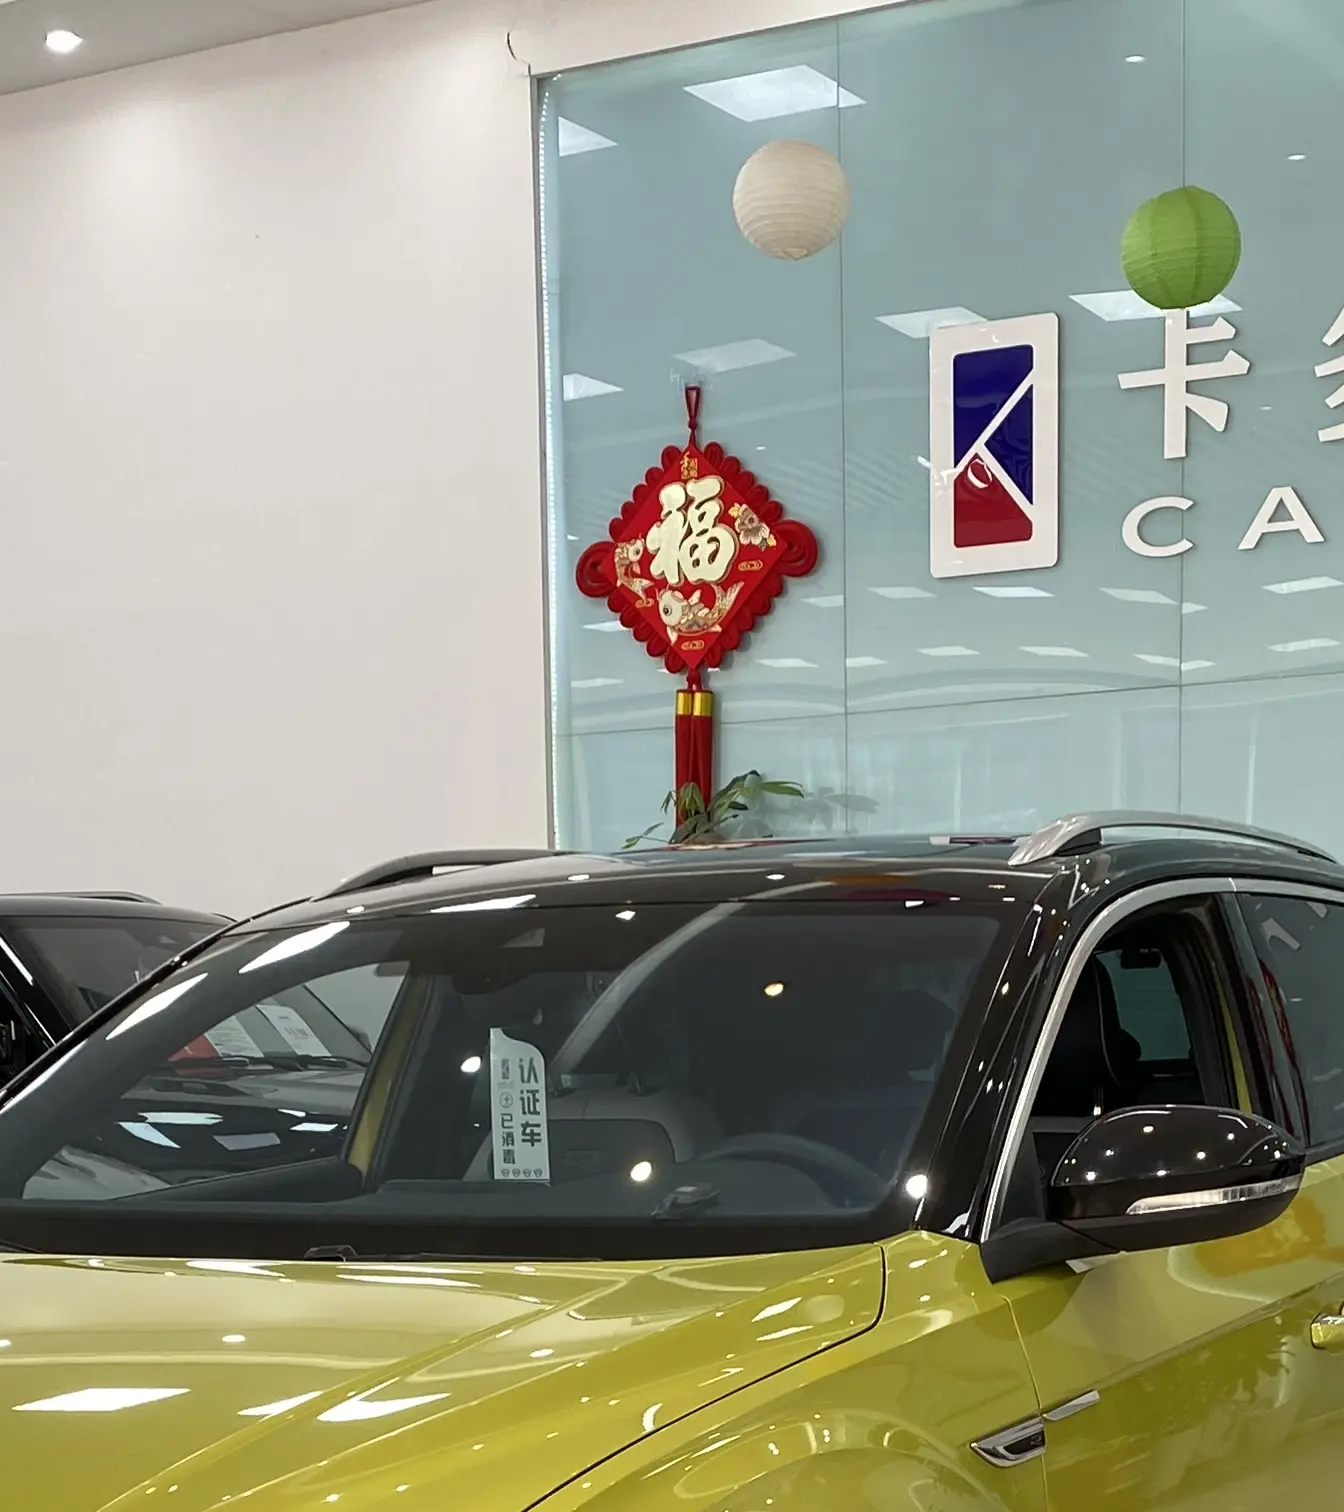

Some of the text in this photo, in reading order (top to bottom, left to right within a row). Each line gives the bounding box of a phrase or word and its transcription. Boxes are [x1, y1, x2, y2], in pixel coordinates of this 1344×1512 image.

[646, 475, 739, 586] 福
[518, 1057, 542, 1147] 认证车
